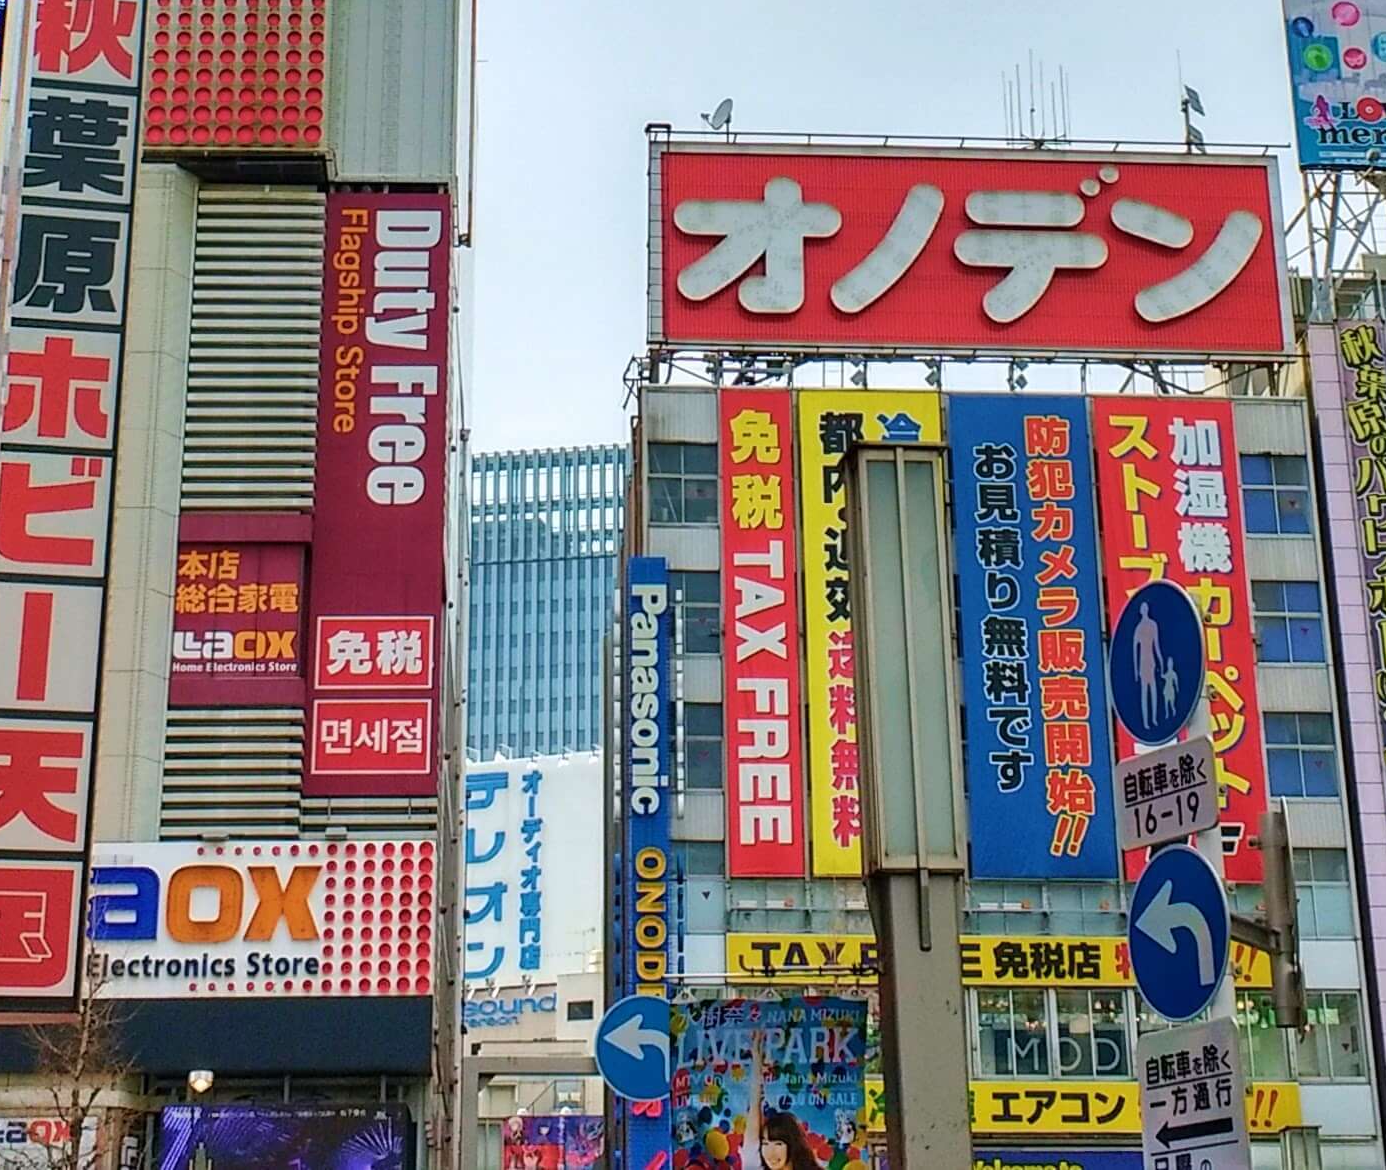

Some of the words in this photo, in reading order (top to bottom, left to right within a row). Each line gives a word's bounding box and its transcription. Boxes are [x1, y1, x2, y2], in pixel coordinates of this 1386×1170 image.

[329, 208, 370, 336] Flagship
[365, 209, 442, 350] Duty
[673, 176, 1264, 324] オノデン
[332, 344, 365, 435] Store
[365, 365, 438, 507] Free
[729, 408, 784, 530] 免税
[174, 582, 299, 614] 総合家電
[177, 549, 241, 582] 本店
[733, 540, 787, 661] TAX
[325, 629, 424, 676] 免税
[971, 443, 1033, 794] お見積り無料です
[1021, 413, 1098, 858] 防犯カメラ販売開始!!
[171, 661, 204, 674] Home
[207, 661, 266, 674] Electronics
[268, 661, 298, 674] Store
[632, 583, 667, 815] Panasonic
[321, 718, 424, 756] 면세점
[738, 678, 792, 845] FREE
[1124, 753, 1208, 802] 自転車を除く
[1133, 790, 1200, 839] 16-19
[519, 769, 544, 972] オーディオ専門店
[635, 846, 668, 999] ONOD
[87, 951, 235, 979] Electronics
[246, 951, 320, 979] Store
[993, 942, 1102, 980] 免税店
[764, 1026, 859, 1066] PARK
[1145, 1043, 1231, 1086] 自転車を除く
[991, 1090, 1126, 1125] エアコン
[1148, 1079, 1233, 1116] 一方通行
